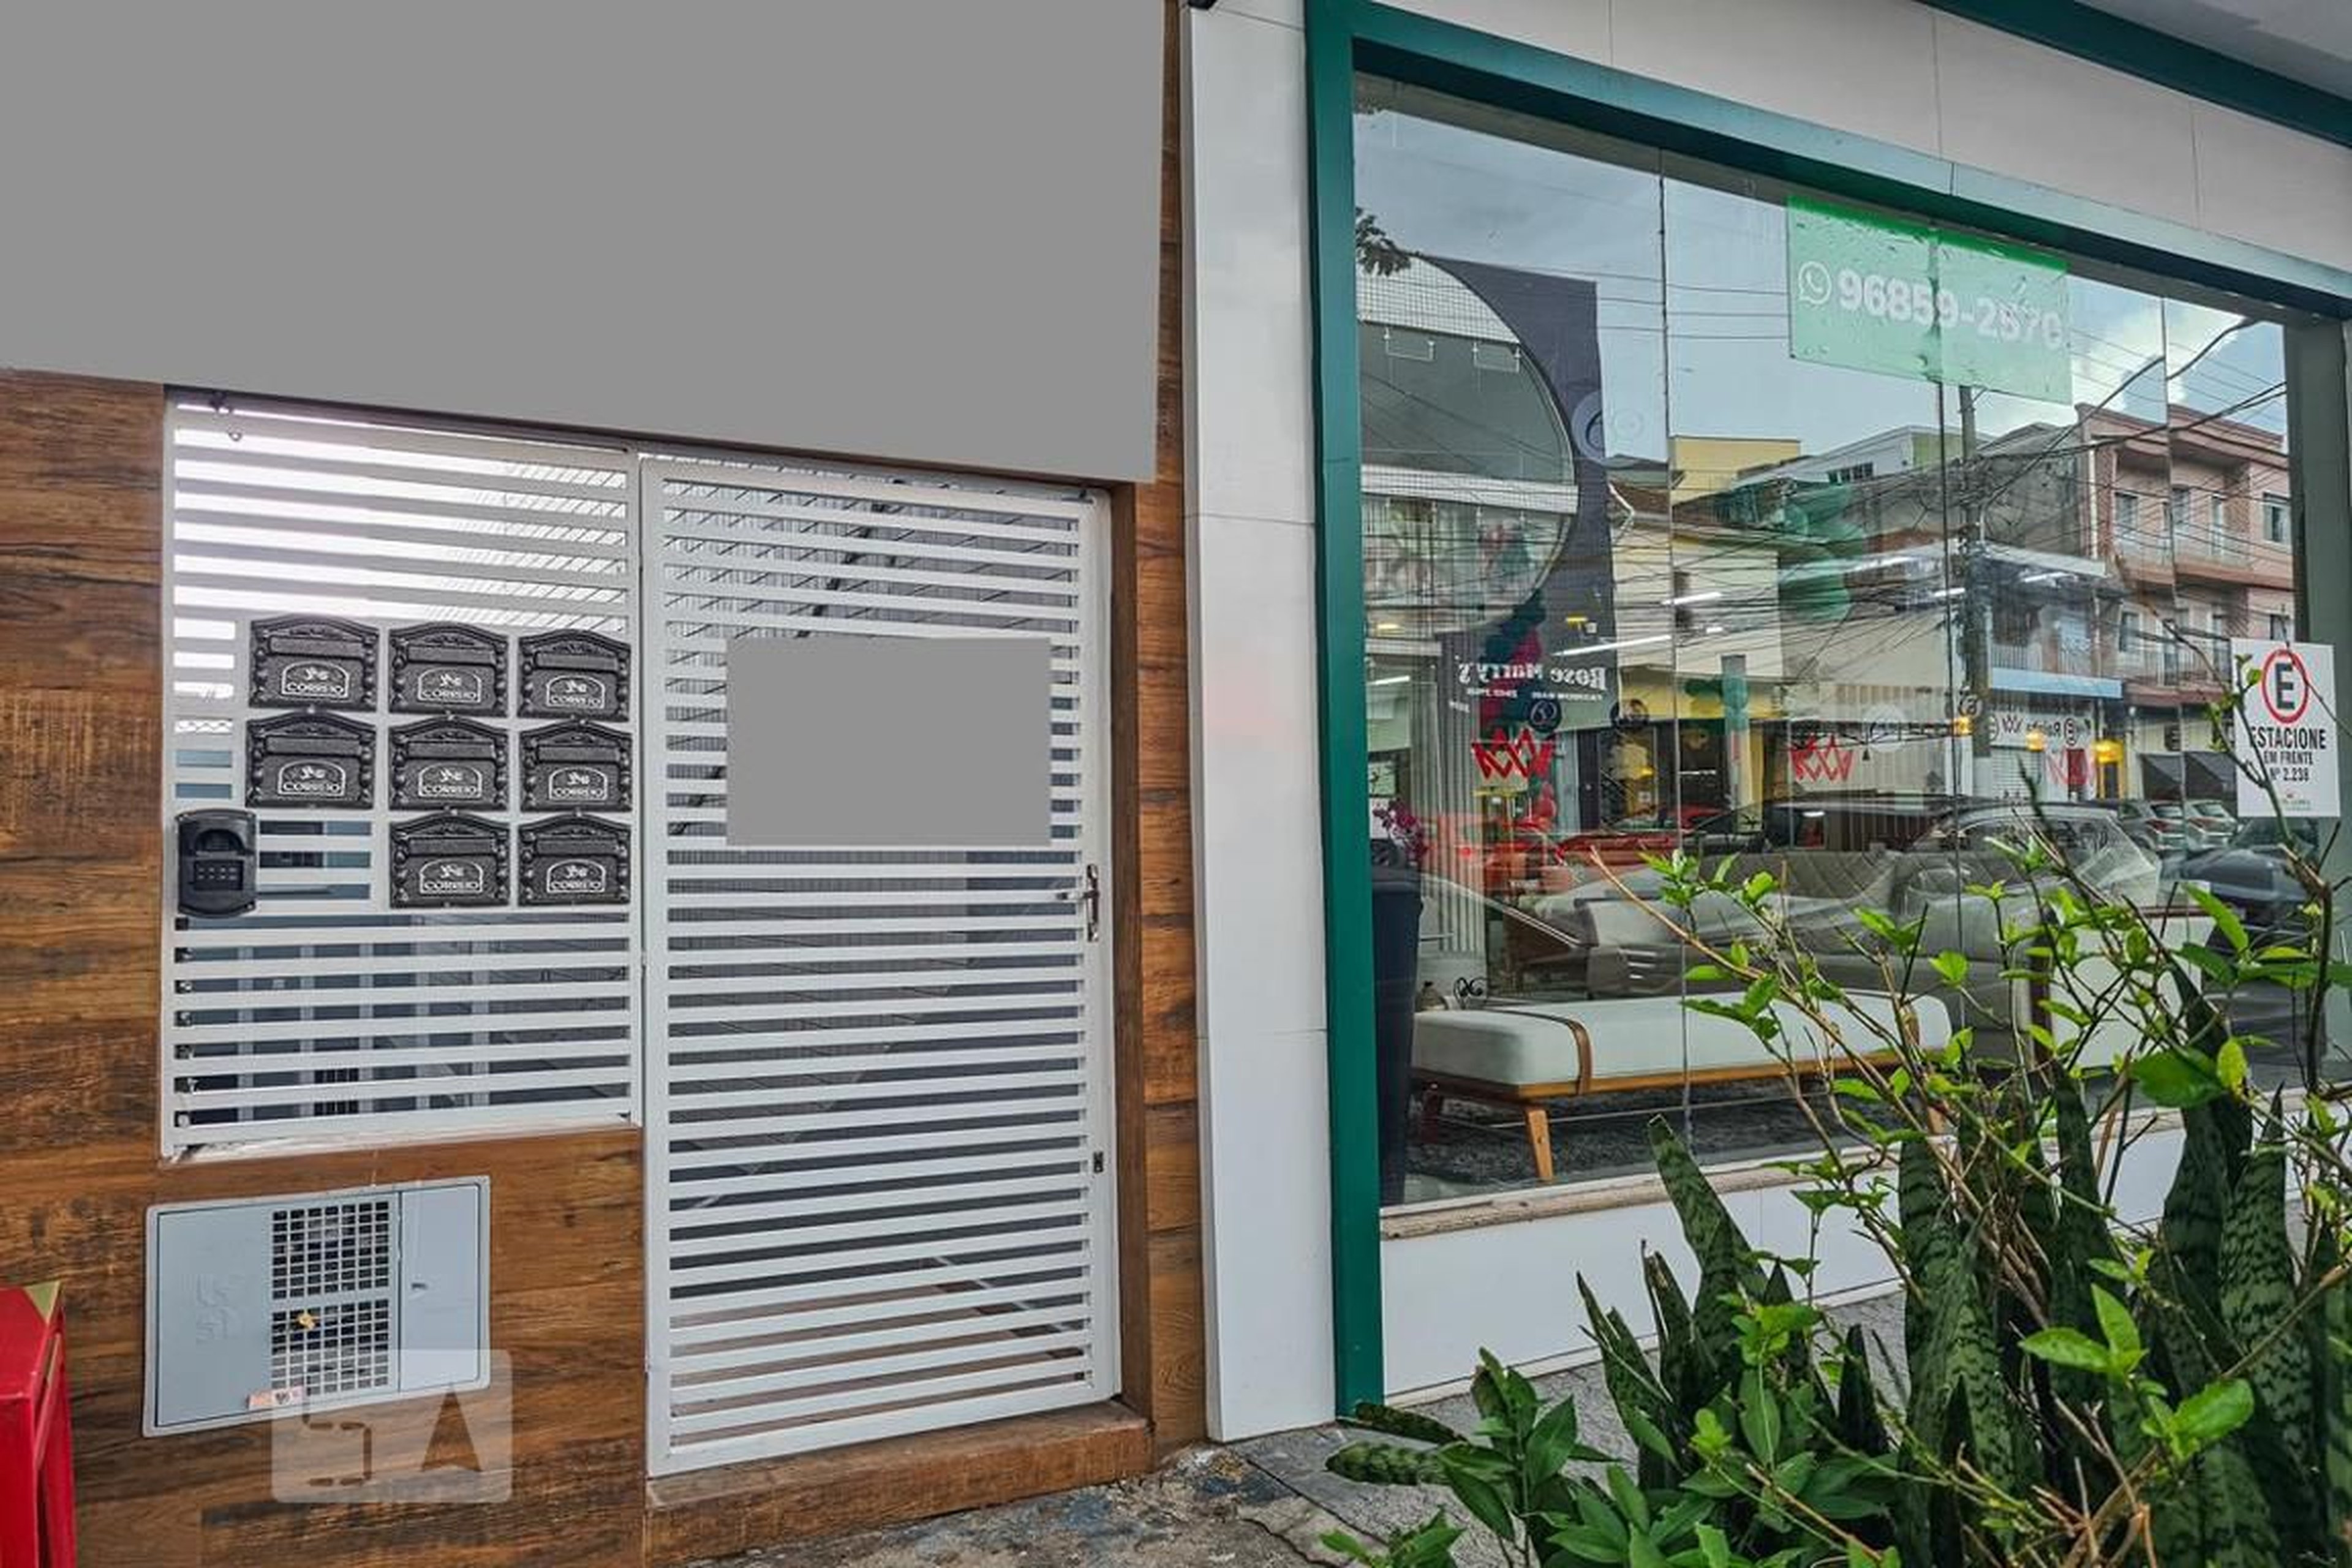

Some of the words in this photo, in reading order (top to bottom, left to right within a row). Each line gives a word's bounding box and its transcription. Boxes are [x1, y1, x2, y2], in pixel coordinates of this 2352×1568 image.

[2275, 662, 2296, 710] E
[2264, 751, 2277, 764] EM
[2280, 751, 2313, 765] FRENTE
